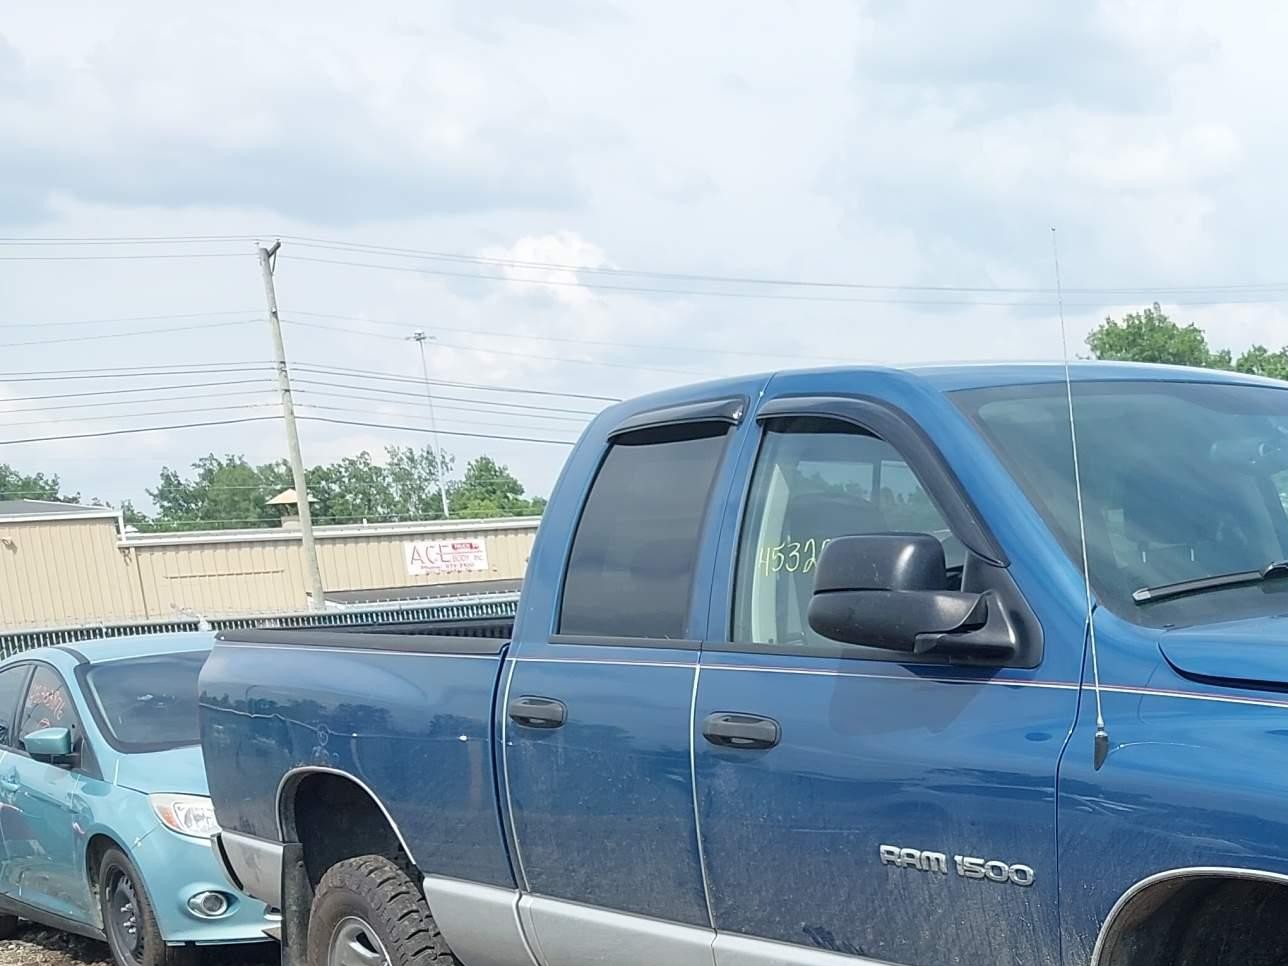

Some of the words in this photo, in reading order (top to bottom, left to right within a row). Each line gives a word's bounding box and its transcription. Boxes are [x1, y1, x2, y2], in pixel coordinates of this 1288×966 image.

[410, 543, 450, 566] ACE
[879, 844, 948, 874] RAM
[953, 854, 1035, 887] 1500
